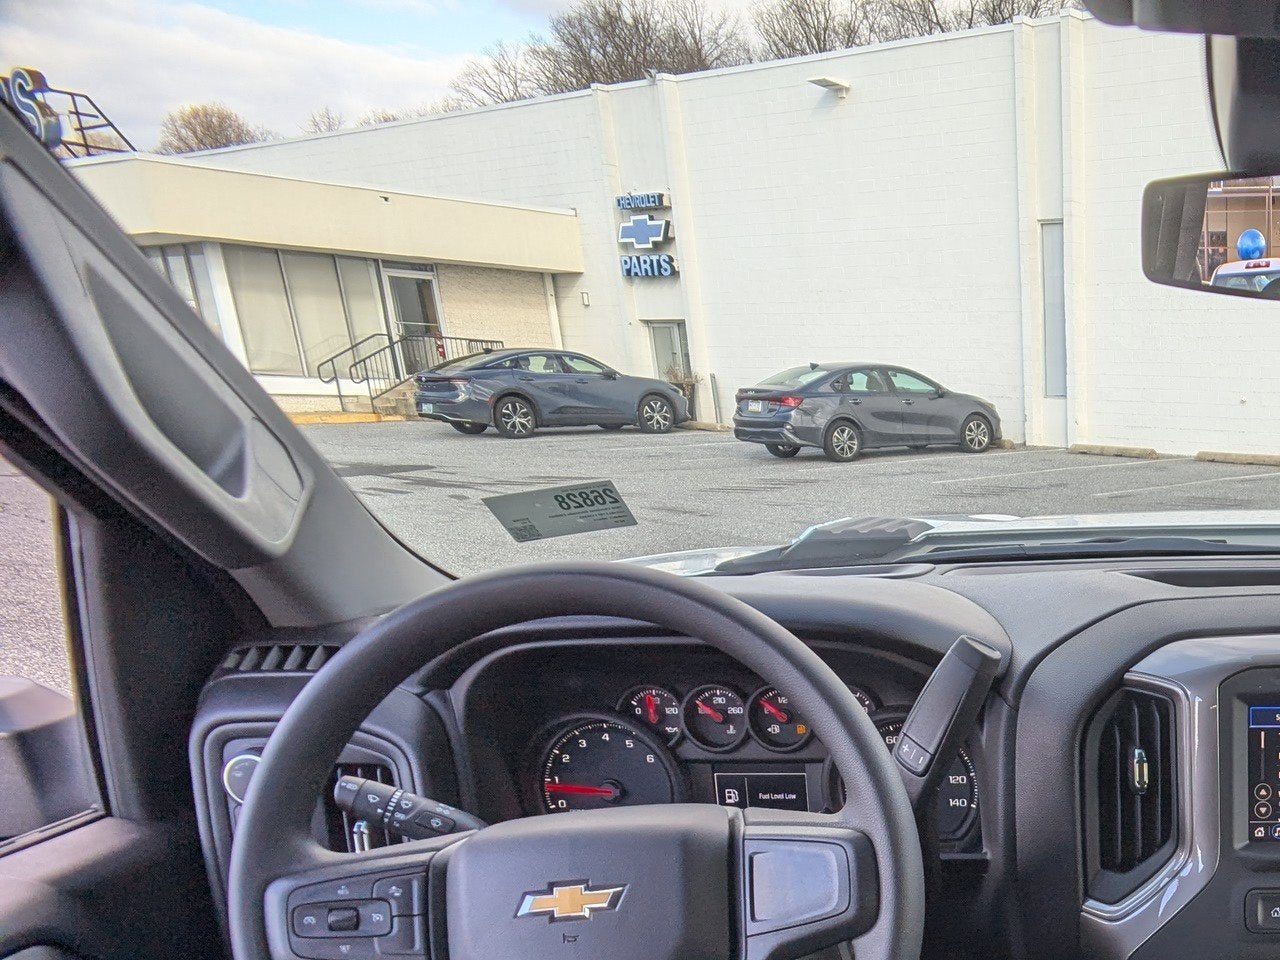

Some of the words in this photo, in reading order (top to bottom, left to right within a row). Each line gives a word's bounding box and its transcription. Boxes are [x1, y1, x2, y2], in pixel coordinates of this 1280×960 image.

[616, 192, 661, 210] CHEVROLET
[620, 254, 672, 277] PARTS
[601, 733, 610, 742] 4
[578, 739, 587, 748] 3
[625, 739, 634, 748] 5
[562, 754, 570, 763] 2
[646, 754, 655, 763] 6
[948, 776, 967, 784] 120
[558, 800, 567, 809] 0
[949, 799, 967, 807] 140
